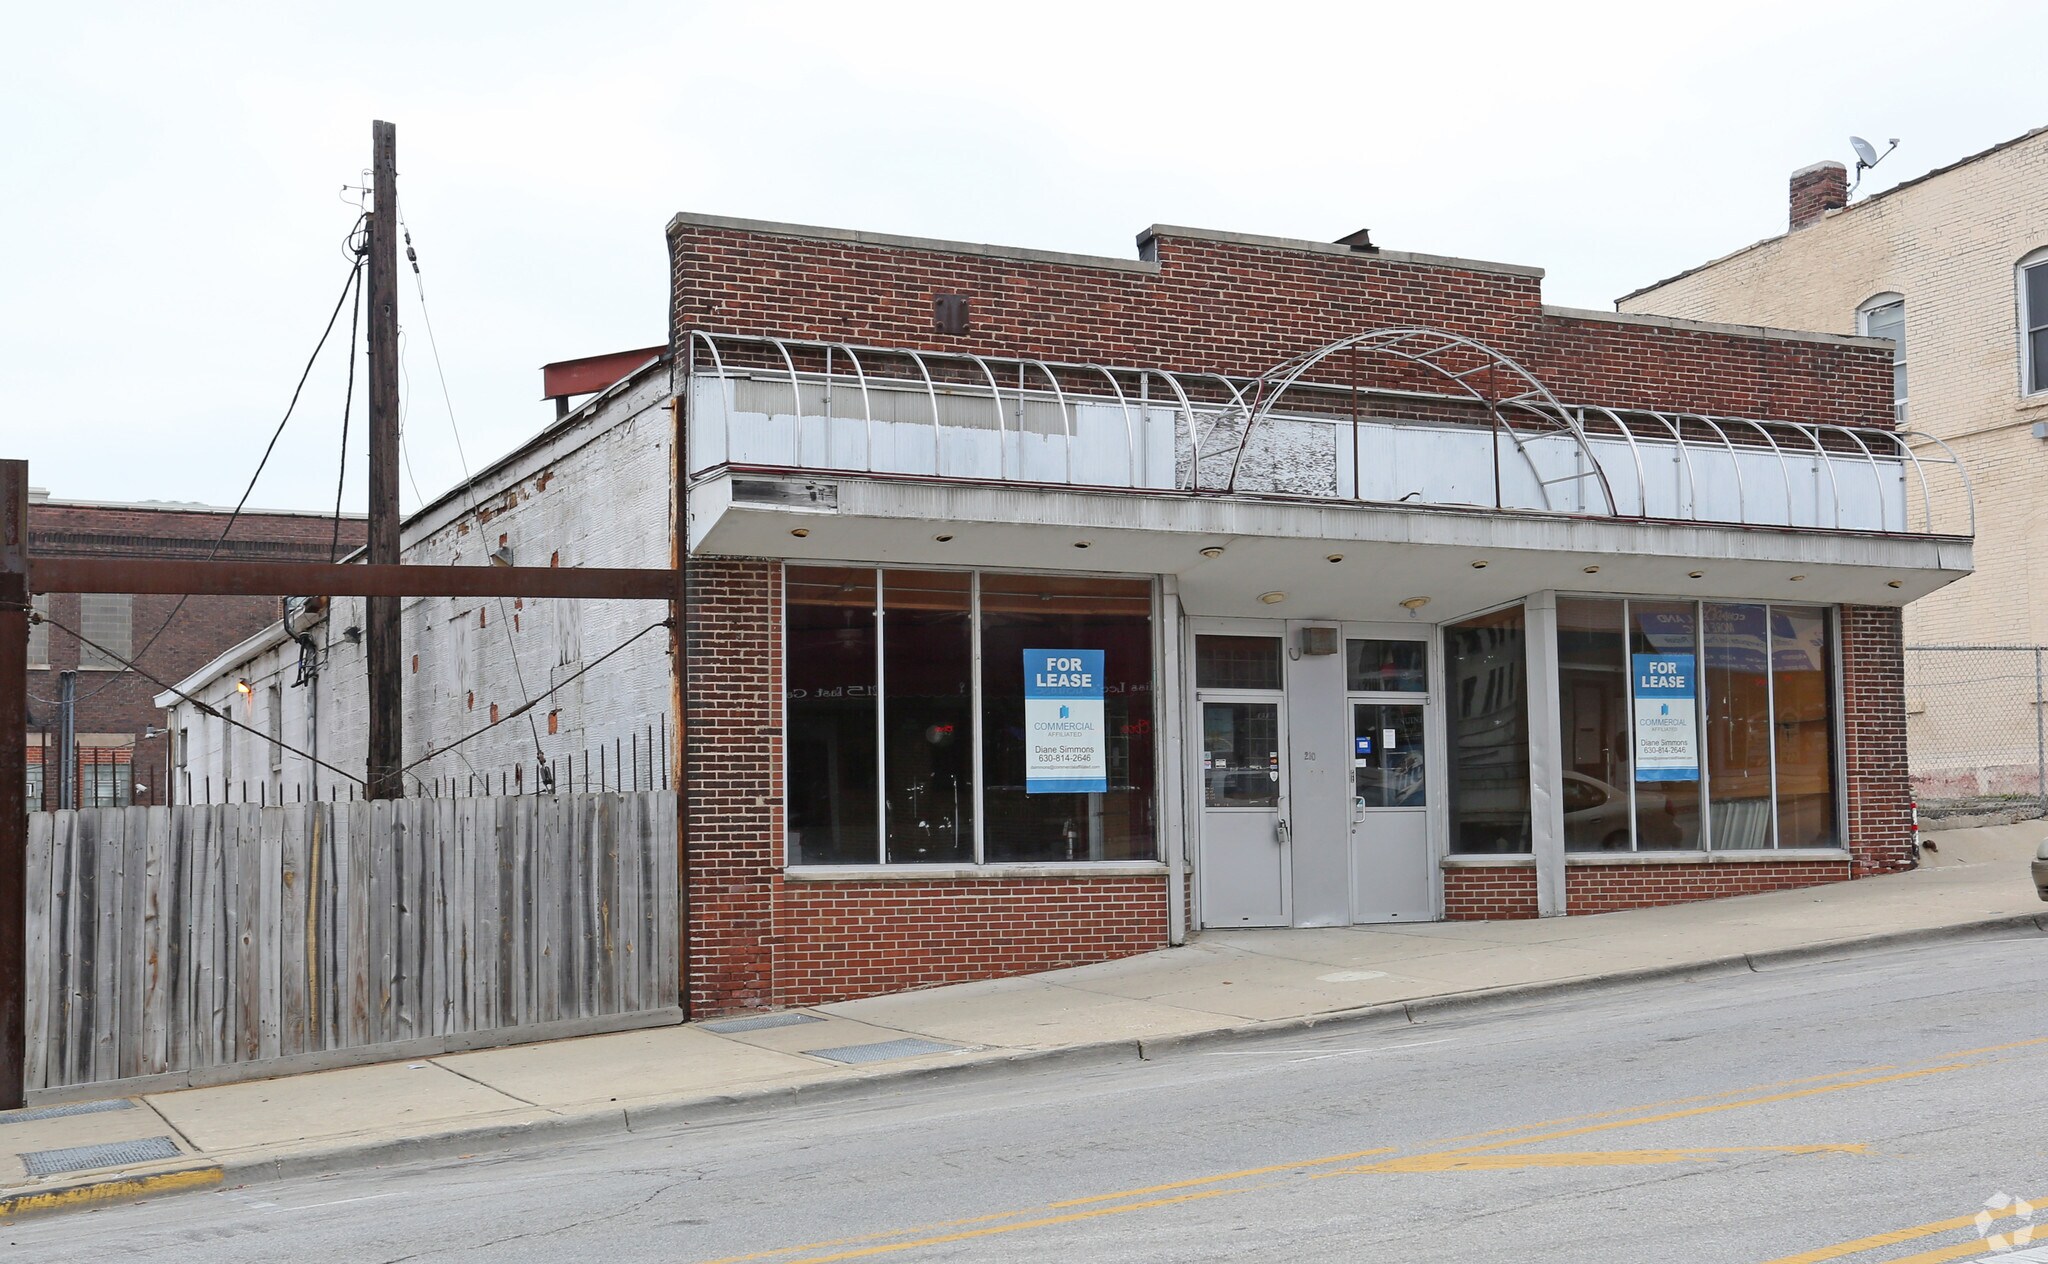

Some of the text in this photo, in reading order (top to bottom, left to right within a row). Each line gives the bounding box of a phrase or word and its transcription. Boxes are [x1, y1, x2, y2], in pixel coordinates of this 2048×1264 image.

[1047, 658, 1082, 671] FOR
[1649, 662, 1677, 674] FOR
[1036, 674, 1092, 688] LEASE
[1641, 675, 1685, 688] LEASE
[1034, 722, 1095, 731] COMMERCIAL
[1640, 718, 1687, 726] COMMERCIAL
[1641, 739, 1688, 747] Diane Simmons
[1035, 745, 1094, 754] Diane Simmons
[1644, 746, 1686, 754] 630-814-2646
[1038, 754, 1091, 763] 630-814-2646
